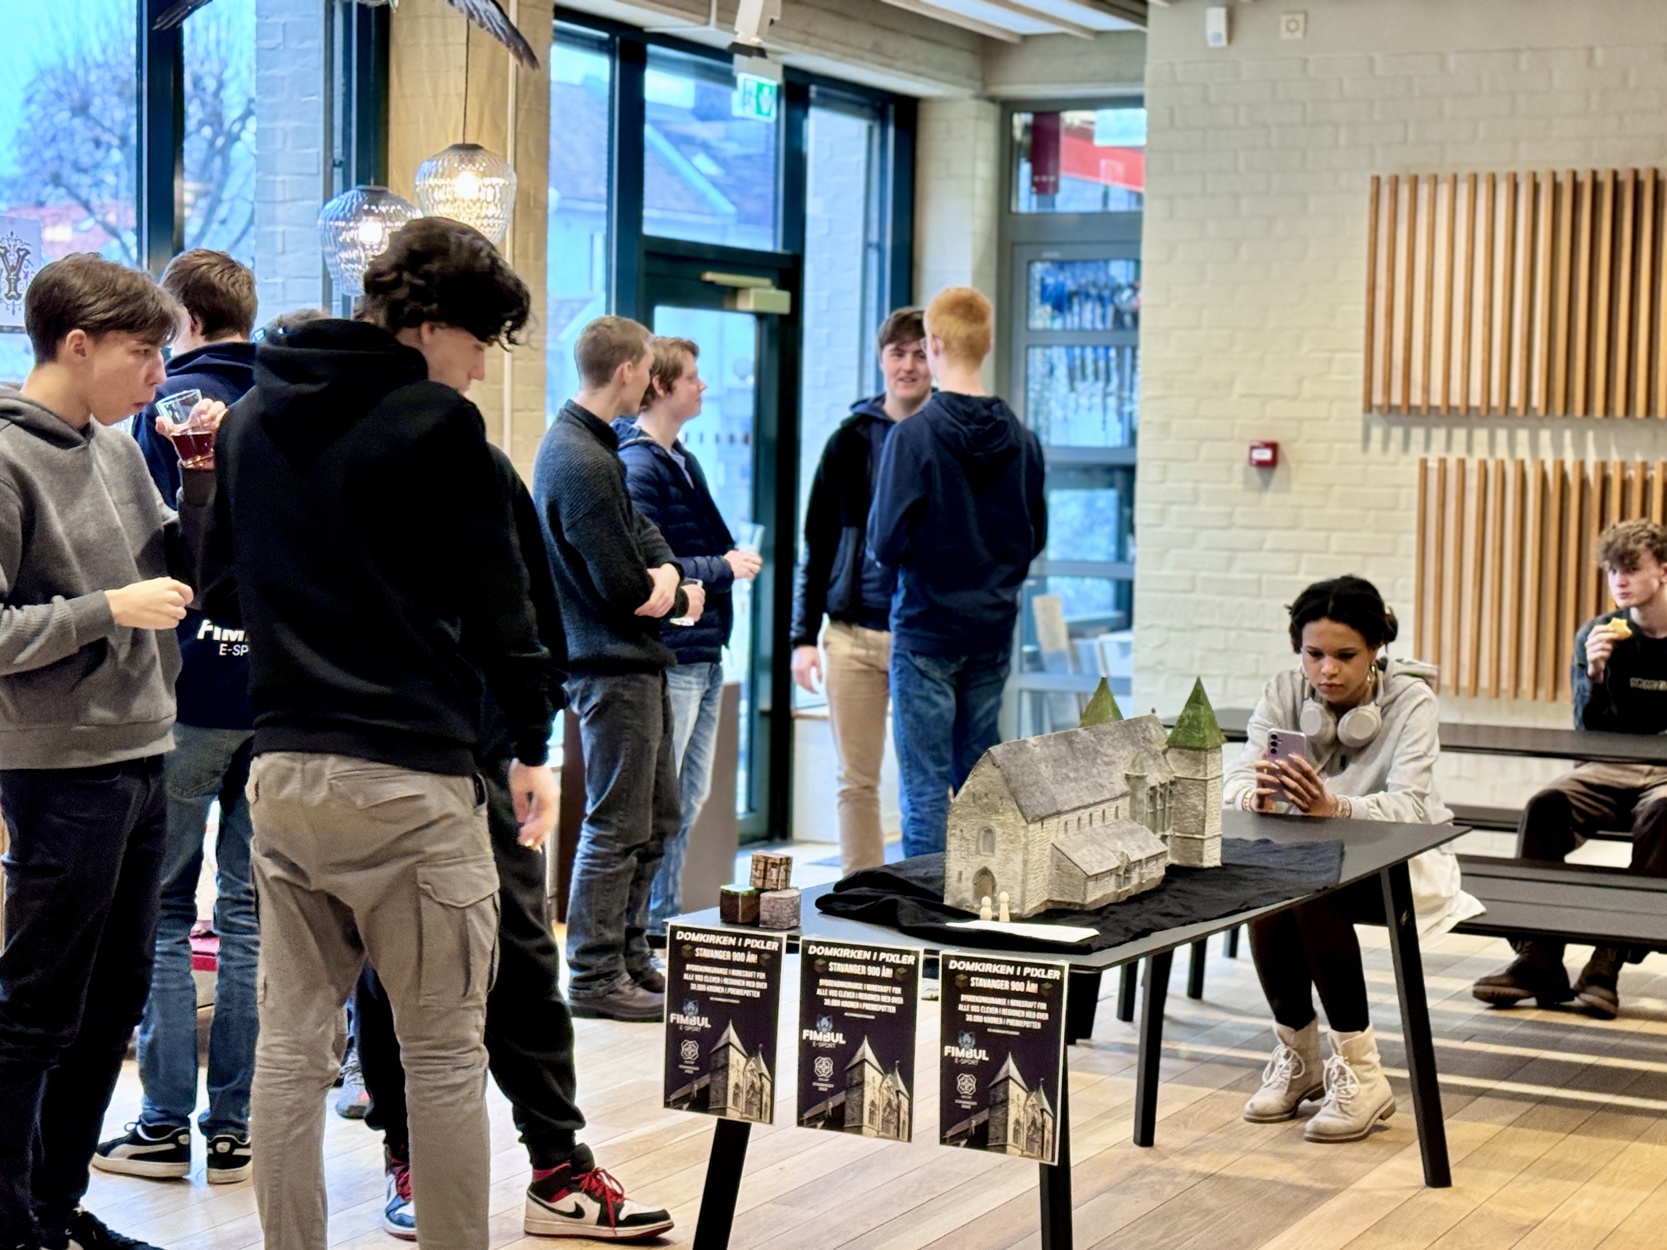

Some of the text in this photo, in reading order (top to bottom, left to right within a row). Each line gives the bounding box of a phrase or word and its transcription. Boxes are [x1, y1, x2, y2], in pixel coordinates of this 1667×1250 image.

[197, 619, 248, 641] FIM
[219, 643, 248, 656] E-SP
[676, 931, 779, 951] DOMKIRKEN I PIXLER
[695, 947, 758, 964] STAVANGER 900 ÅR!
[808, 945, 916, 965] DOMKIRKEN I PIXLER
[828, 962, 893, 978] STAVANGER 900 ÅR!
[948, 960, 1060, 980] DOMKIRKEN I PIXLER
[970, 977, 1038, 993] STAVANGER 900 ÅR!
[670, 1012, 712, 1028] FIMBUL
[803, 1029, 846, 1044] FIMBUL
[944, 1046, 989, 1060] FIMBUL
